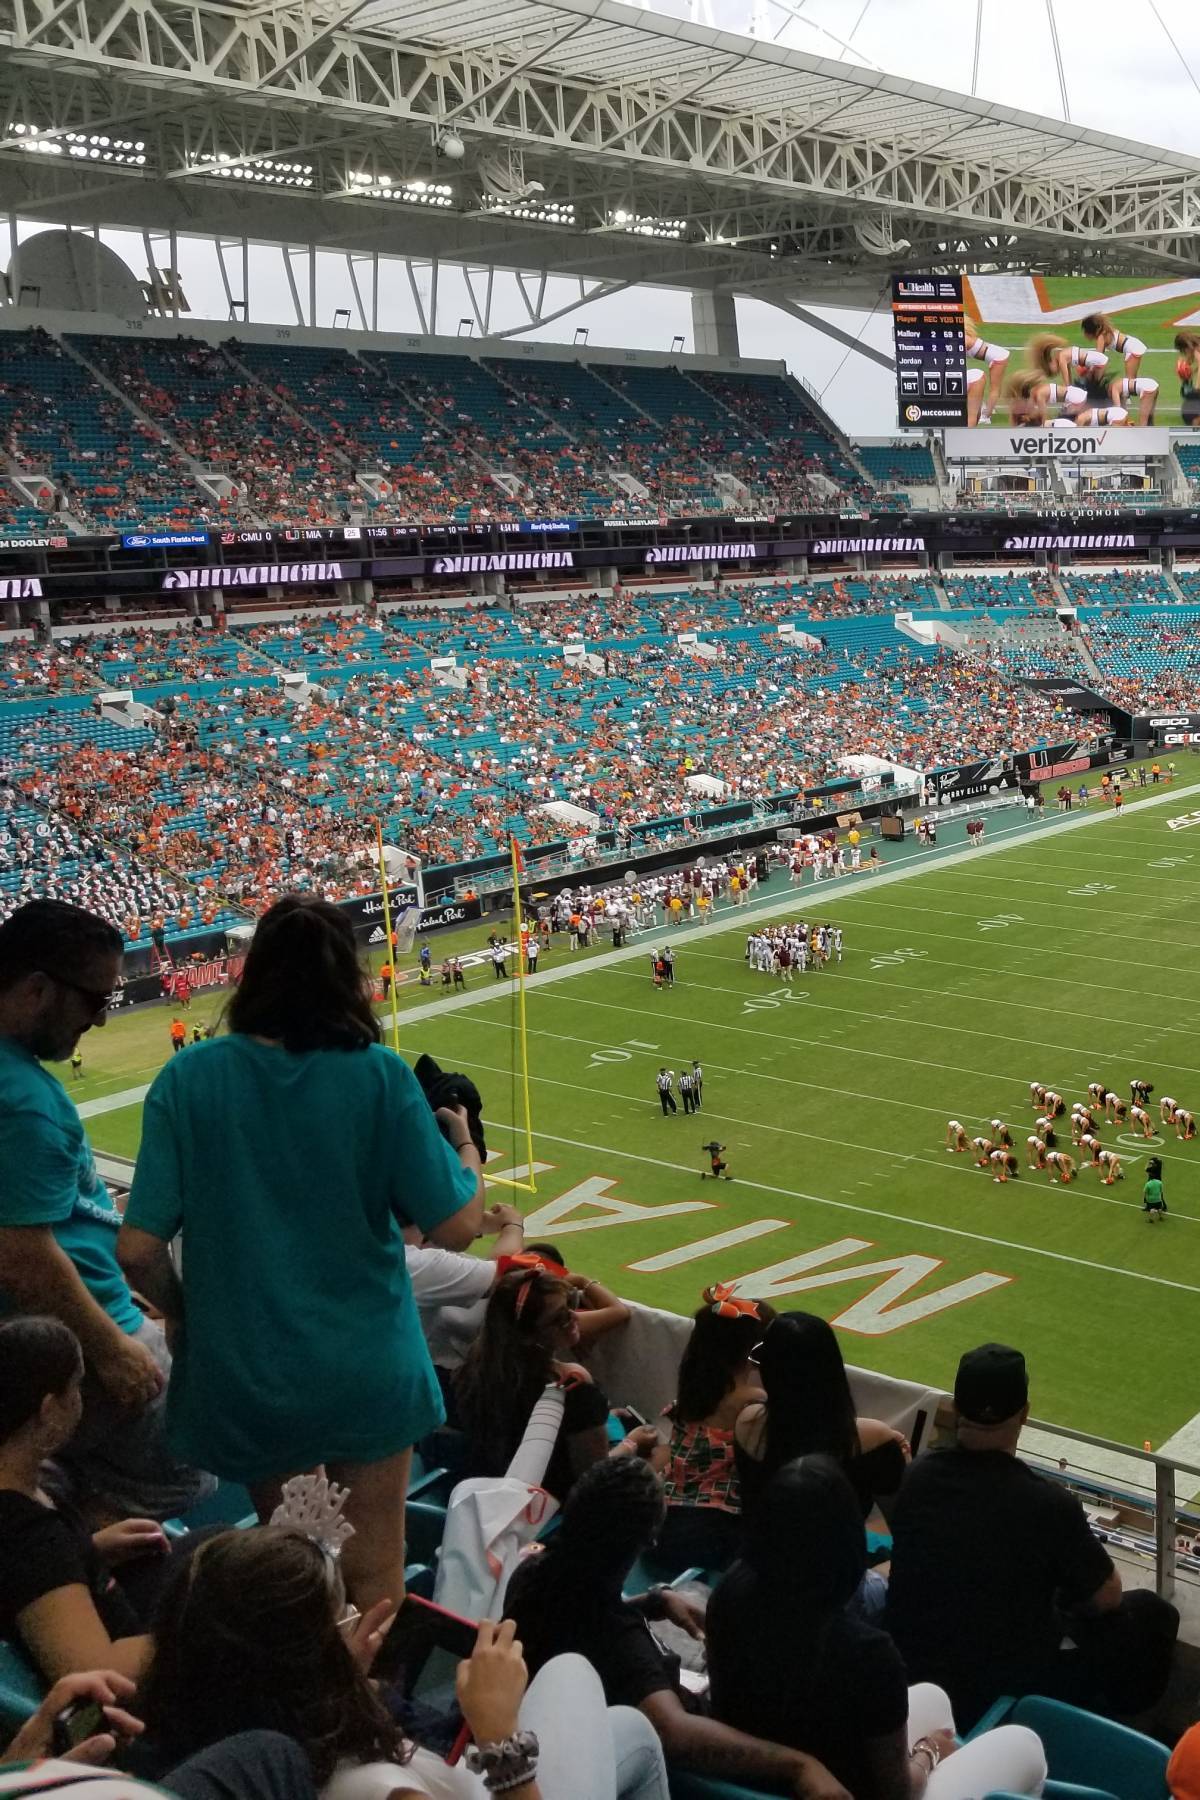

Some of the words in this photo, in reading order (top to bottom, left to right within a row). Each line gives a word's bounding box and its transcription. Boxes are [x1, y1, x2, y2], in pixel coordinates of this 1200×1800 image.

[126, 319, 143, 330] 318
[897, 330, 921, 338] Mallory
[898, 344, 924, 352] Thomas
[899, 357, 922, 365] Jordan
[927, 382, 938, 391] 10
[951, 382, 958, 391] 7
[1010, 433, 1096, 454] verizon
[1078, 509, 1120, 517] HONOR
[306, 530, 322, 539] MIA
[329, 529, 334, 538] 7
[367, 527, 388, 537] 11:56
[449, 525, 456, 534] 10
[12, 539, 50, 548] DOOLEY
[50, 537, 68, 547] 42
[1150, 718, 1189, 727] GEICO
[967, 784, 987, 795] ELLIS
[875, 948, 928, 965] 30
[743, 988, 810, 1010] 20
[590, 1039, 662, 1062] 10
